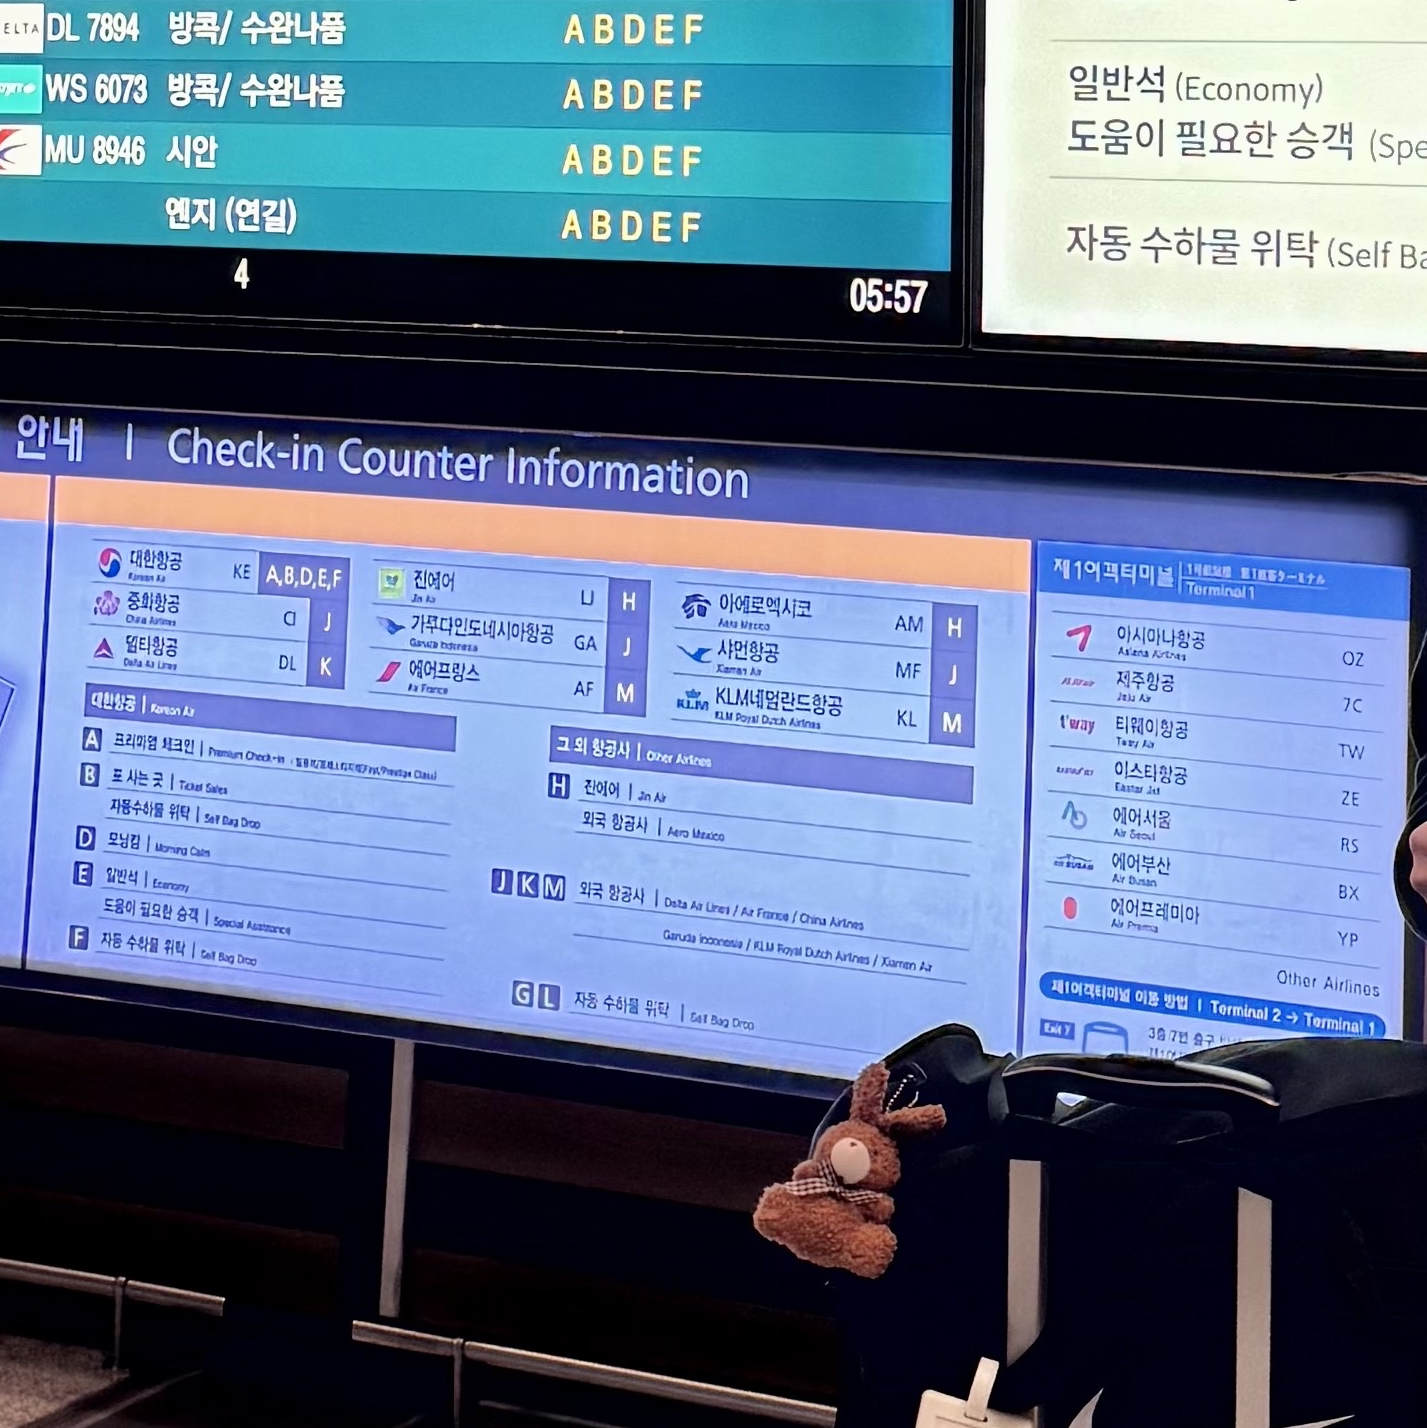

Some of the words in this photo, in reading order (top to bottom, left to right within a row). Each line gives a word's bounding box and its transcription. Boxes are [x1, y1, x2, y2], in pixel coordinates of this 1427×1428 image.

[1070, 65, 1164, 103] 일반석
[1176, 72, 1322, 110] (Economy)
[1068, 119, 1163, 157] 도움이
[1176, 120, 1277, 158] 필요한
[1287, 122, 1352, 161] 승객
[1067, 224, 1131, 261] 자동
[1140, 227, 1240, 265] 수하물
[1251, 229, 1319, 268] 위탁
[1328, 238, 1392, 268] (Self
[17, 415, 83, 462] 안내
[168, 427, 323, 472] Check-in
[338, 438, 494, 482] Counter
[507, 447, 748, 498] Information
[233, 564, 250, 579] KE
[1343, 651, 1364, 667] OZ
[1277, 970, 1317, 987] Other
